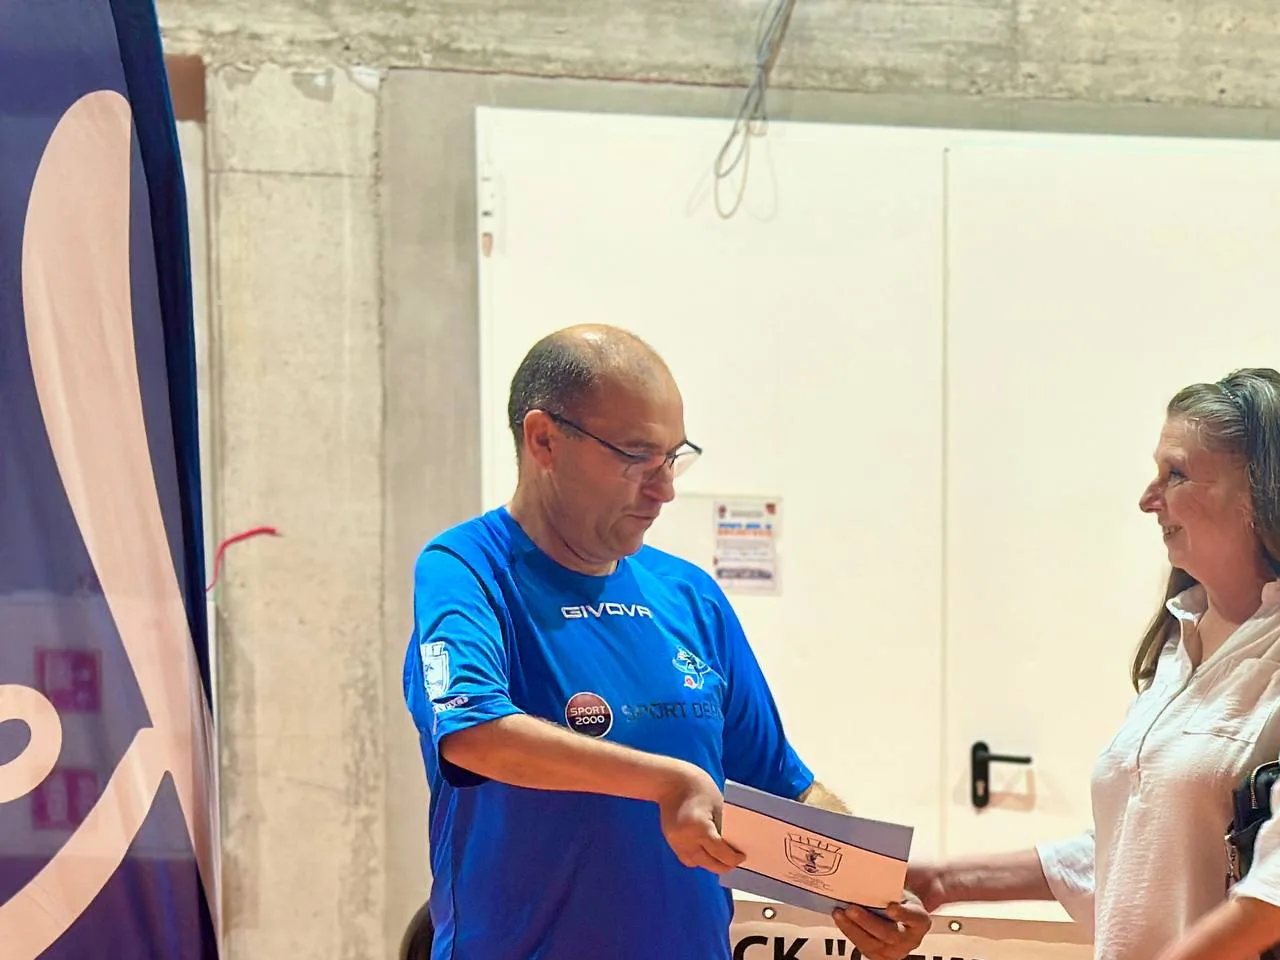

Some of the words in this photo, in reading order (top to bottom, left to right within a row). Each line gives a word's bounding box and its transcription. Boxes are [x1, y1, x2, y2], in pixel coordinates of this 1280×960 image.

[561, 602, 654, 619] GIVOVA
[569, 704, 607, 717] SPORT
[575, 714, 605, 726] 2000
